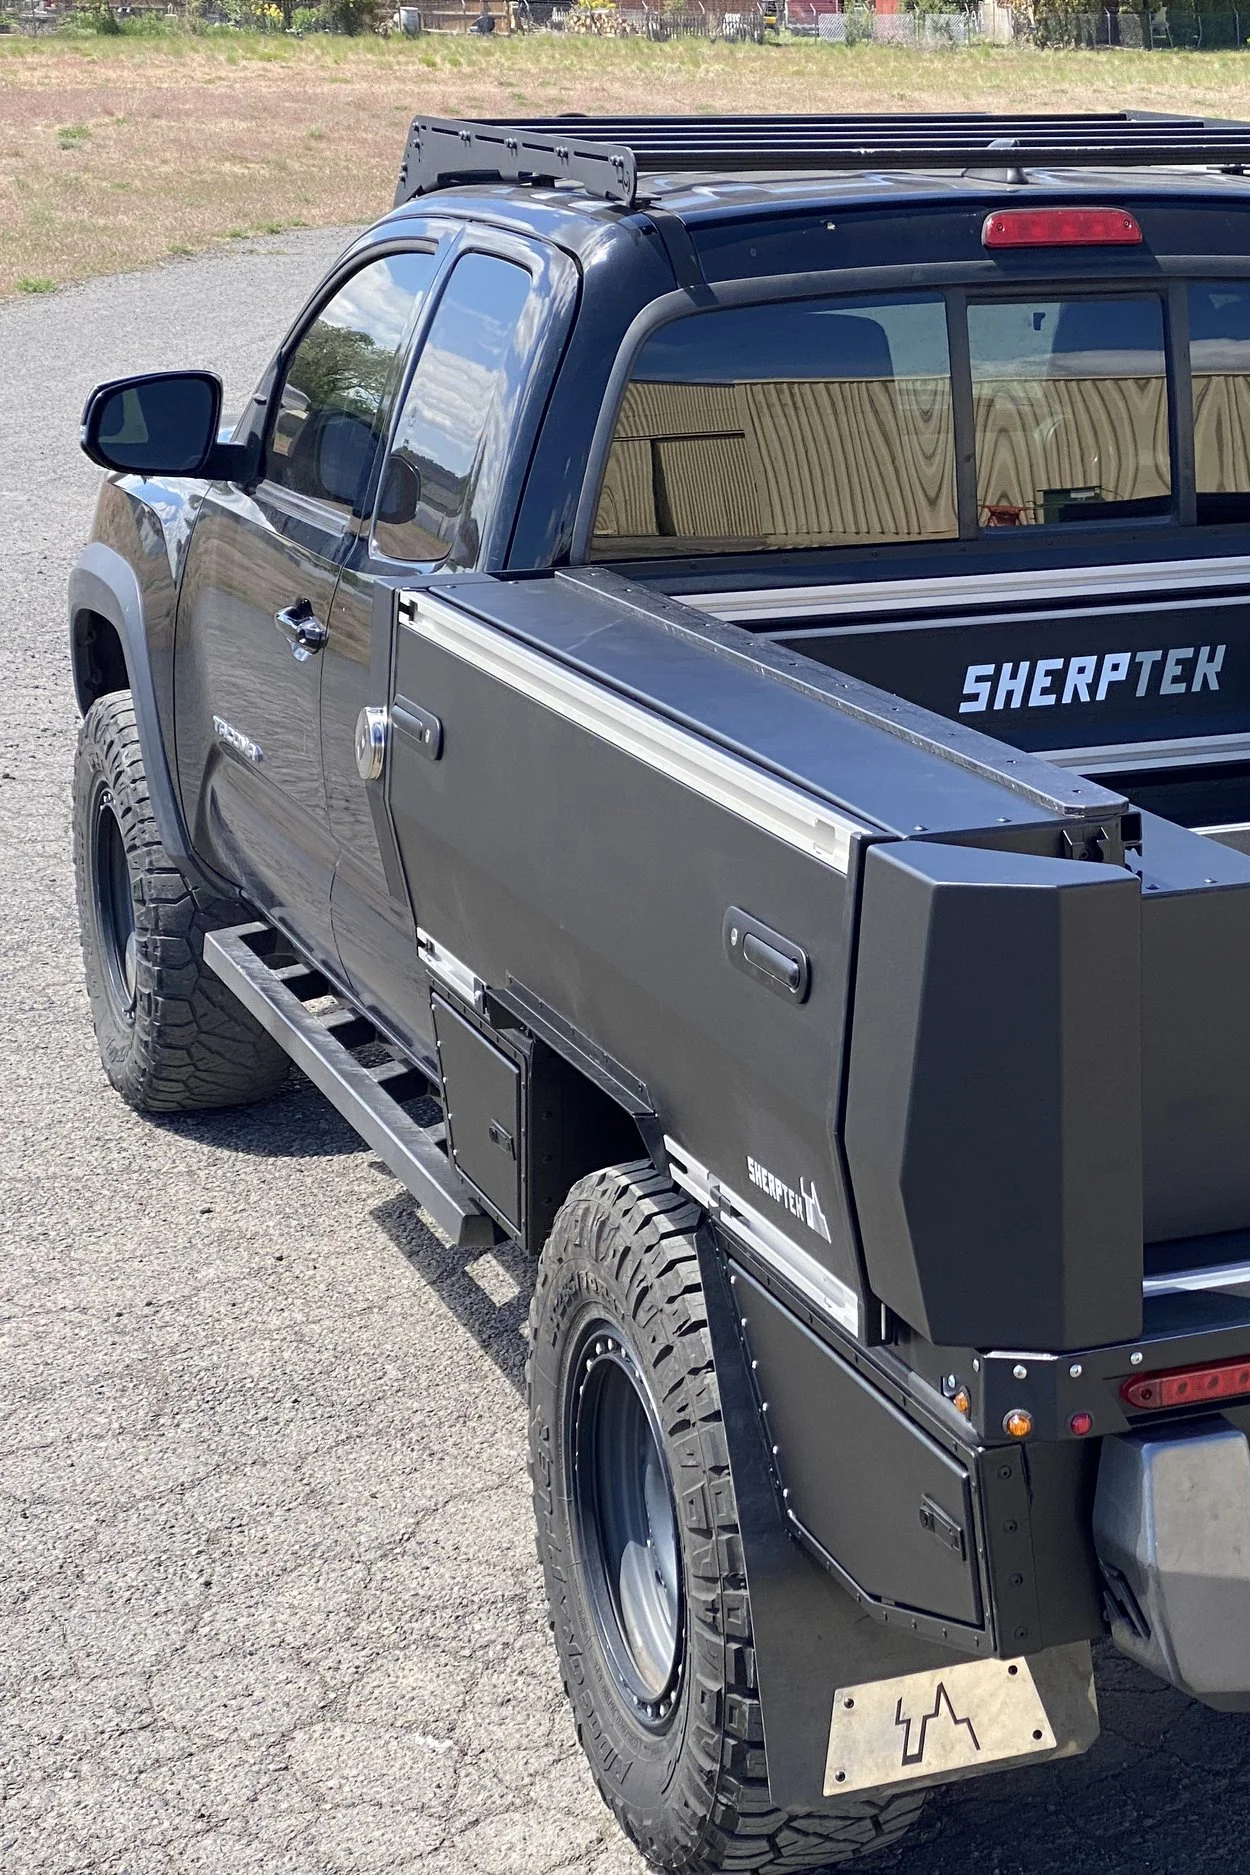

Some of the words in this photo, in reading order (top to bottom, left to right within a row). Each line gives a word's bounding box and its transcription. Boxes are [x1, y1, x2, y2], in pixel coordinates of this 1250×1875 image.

[959, 645, 1226, 713] SHERPTEK
[212, 715, 259, 762] TACOMA
[746, 1155, 804, 1222] SHERPTEK
